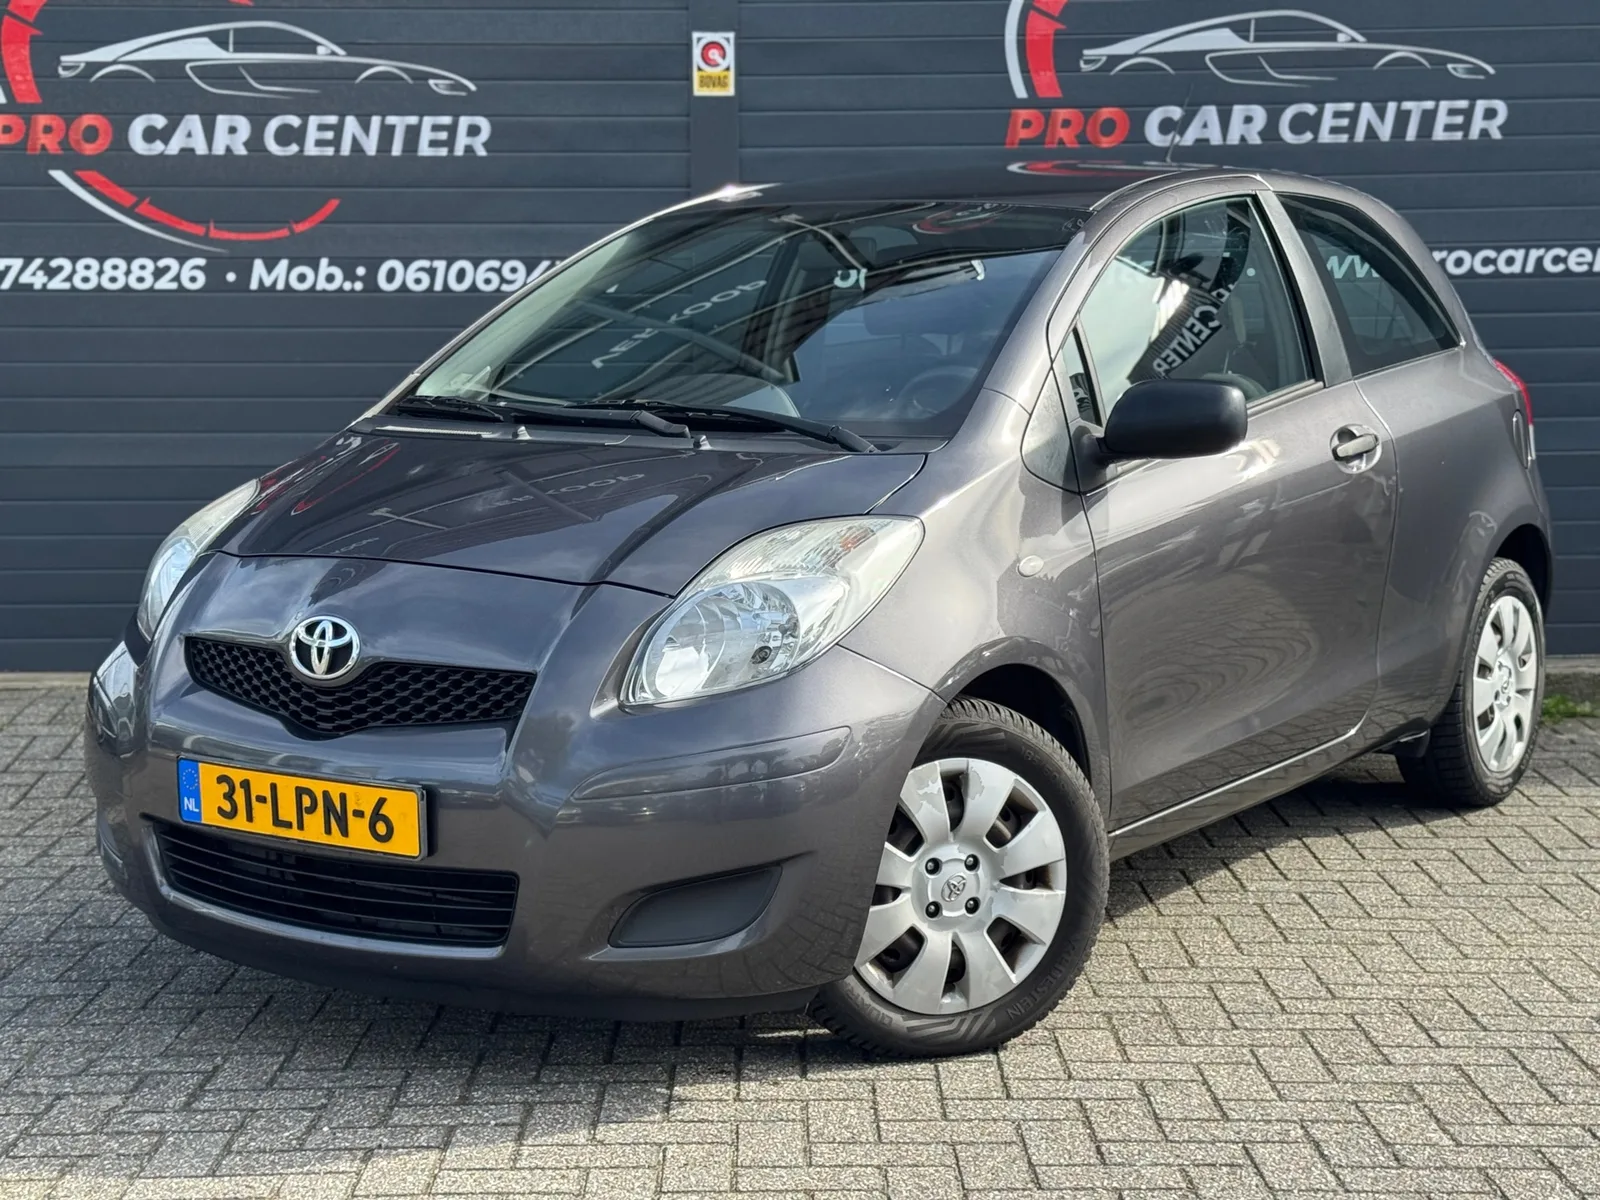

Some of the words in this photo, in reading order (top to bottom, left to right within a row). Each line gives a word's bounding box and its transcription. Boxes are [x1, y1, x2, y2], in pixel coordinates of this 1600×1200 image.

[0, 113, 113, 155] PRO
[127, 114, 252, 156] CAR
[263, 115, 492, 157] CENTER
[1007, 108, 1131, 149] PRO
[1143, 106, 1268, 147] CAR
[1278, 99, 1509, 143] CENTER
[0, 257, 206, 291] 74288826
[249, 258, 365, 292] Mob.:
[183, 796, 200, 813] NL
[216, 774, 394, 844] 31-LPN-6
